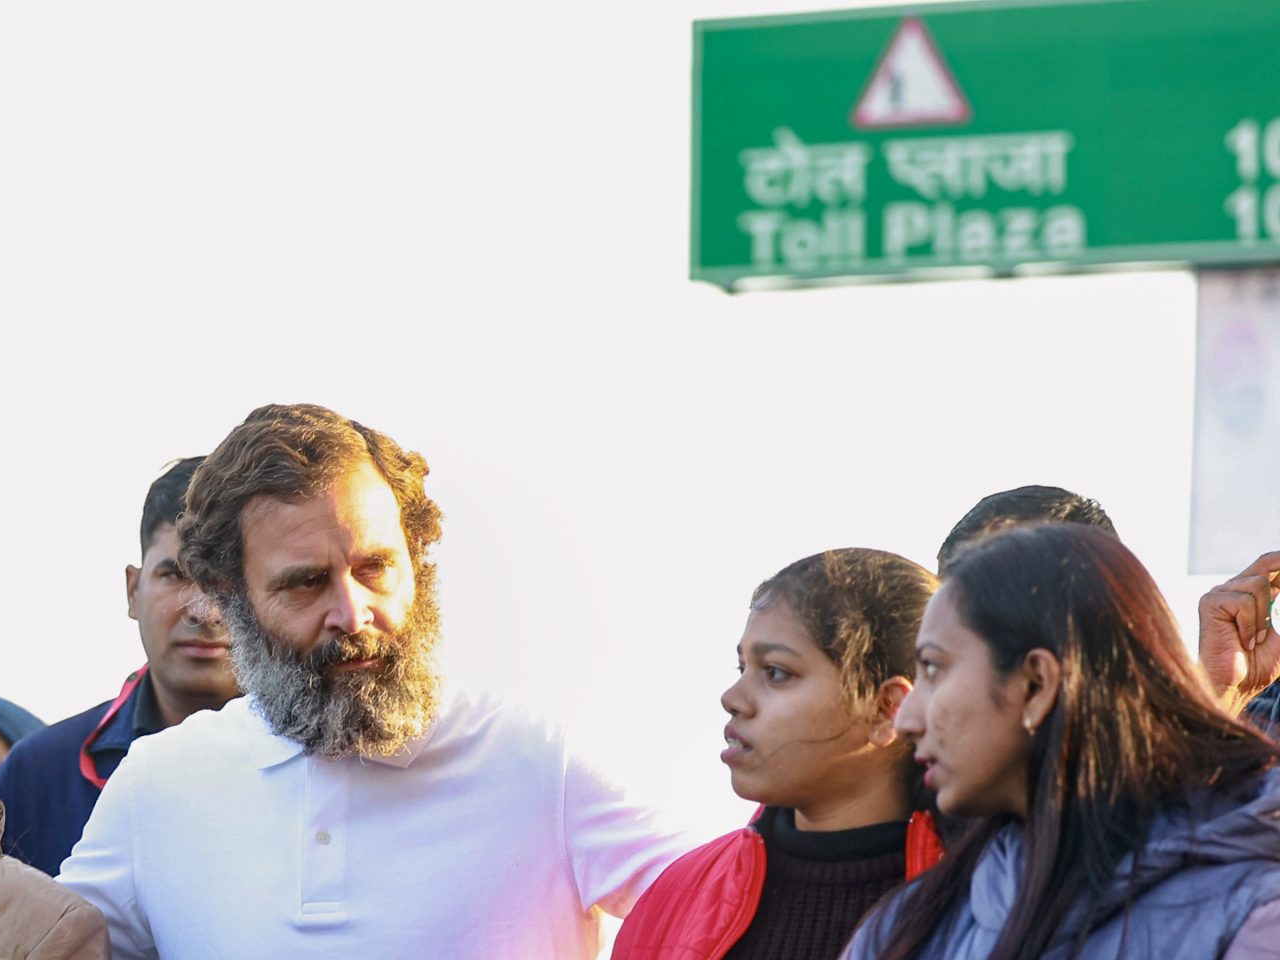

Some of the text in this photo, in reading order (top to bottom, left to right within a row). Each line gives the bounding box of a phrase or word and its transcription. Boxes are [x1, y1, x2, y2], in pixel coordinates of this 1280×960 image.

[740, 125, 872, 208] टोल
[737, 201, 1087, 272] Toll Plaza
